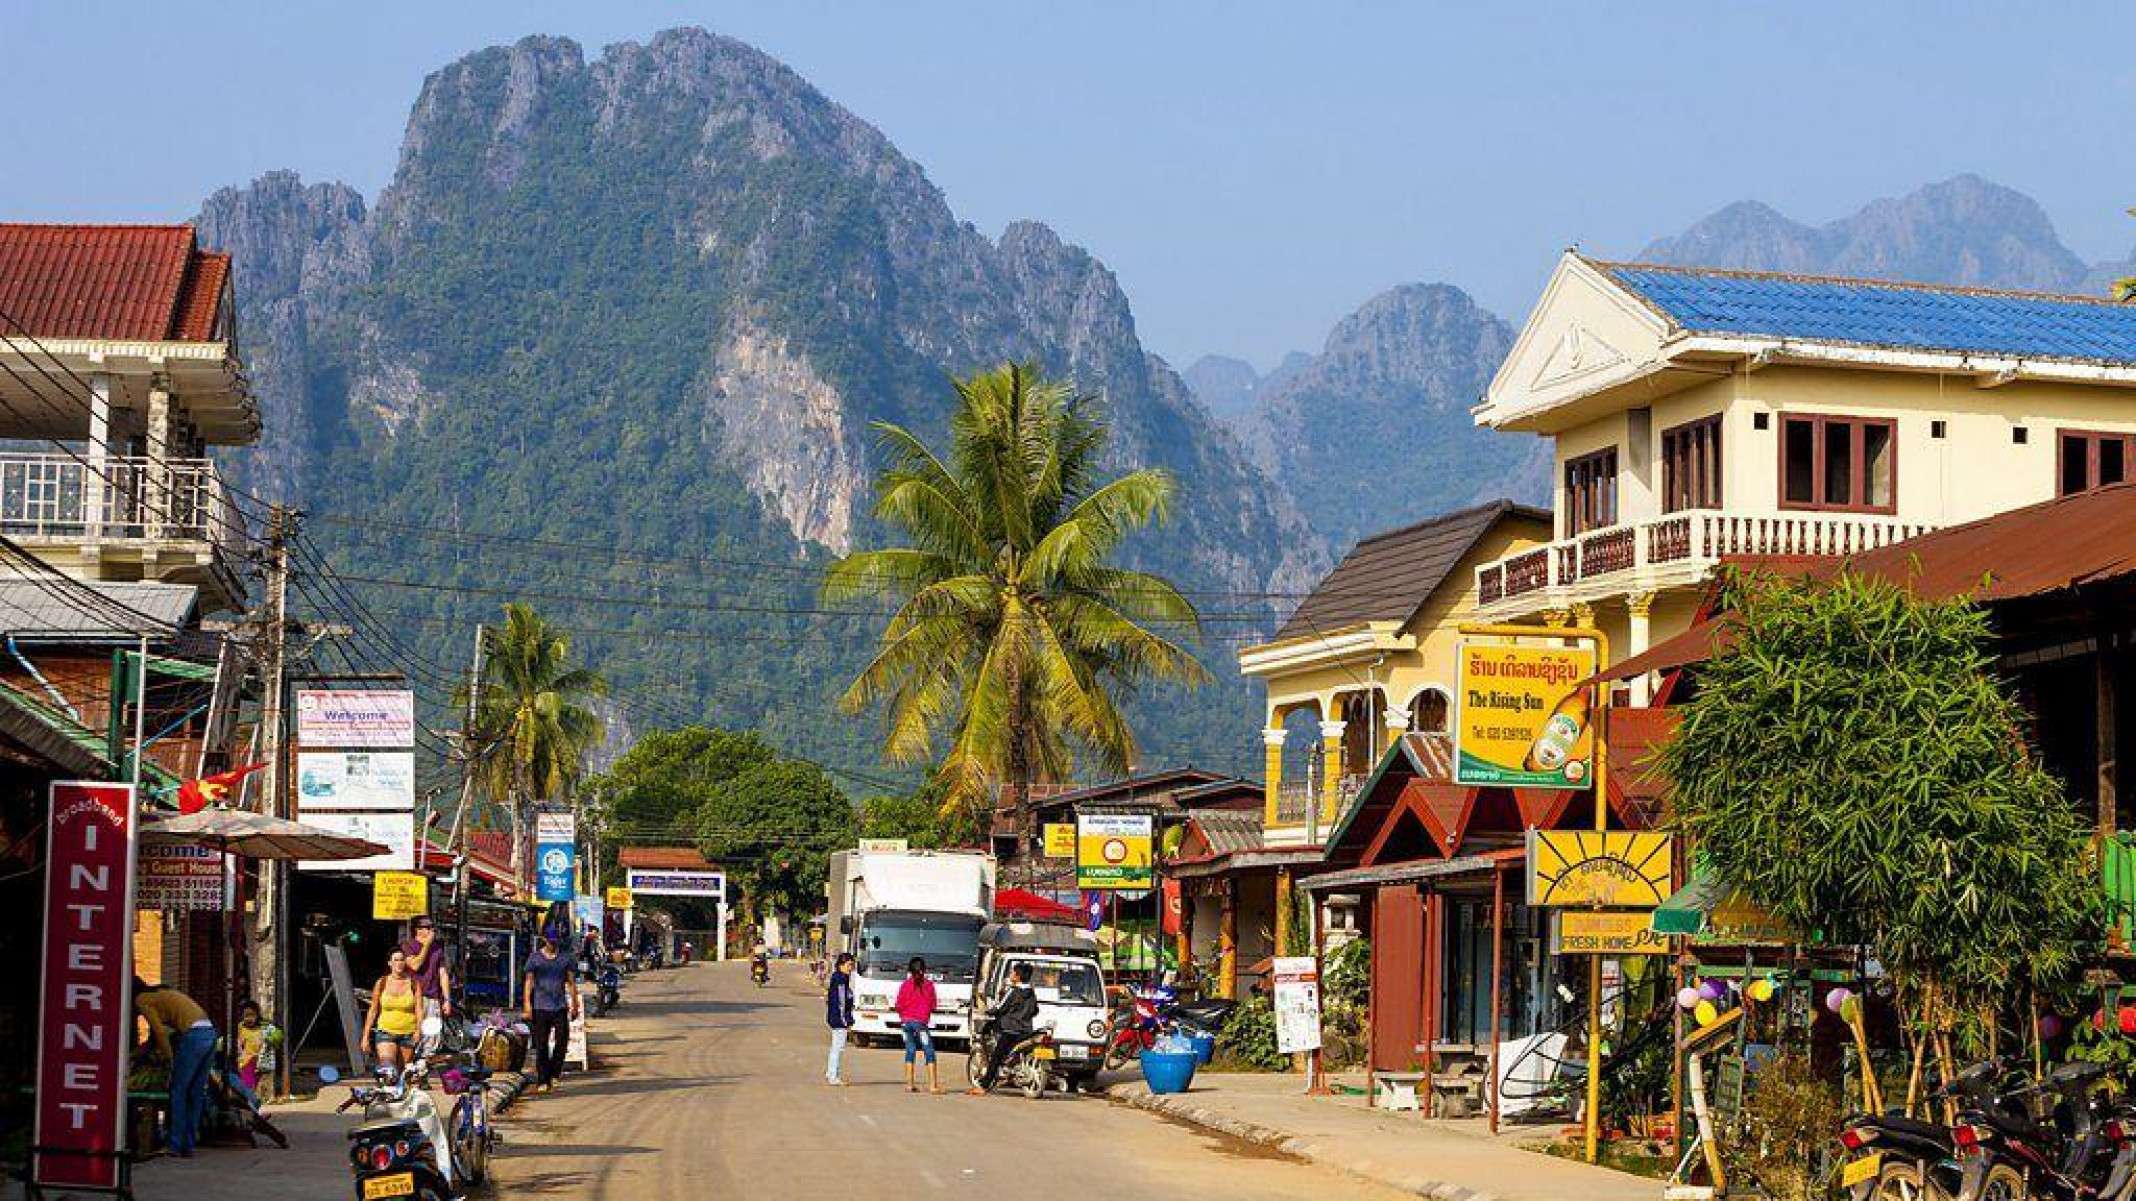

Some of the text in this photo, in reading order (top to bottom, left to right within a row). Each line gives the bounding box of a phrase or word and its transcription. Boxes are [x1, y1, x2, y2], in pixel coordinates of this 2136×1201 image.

[1468, 690, 1545, 713] The Rising Sun
[324, 710, 389, 720] Welcome
[56, 796, 124, 827] broadband
[151, 860, 185, 875] Guest
[1562, 935, 1599, 950] FRESH
[1602, 935, 1633, 950] HOME
[58, 825, 110, 1130] INTERNET
